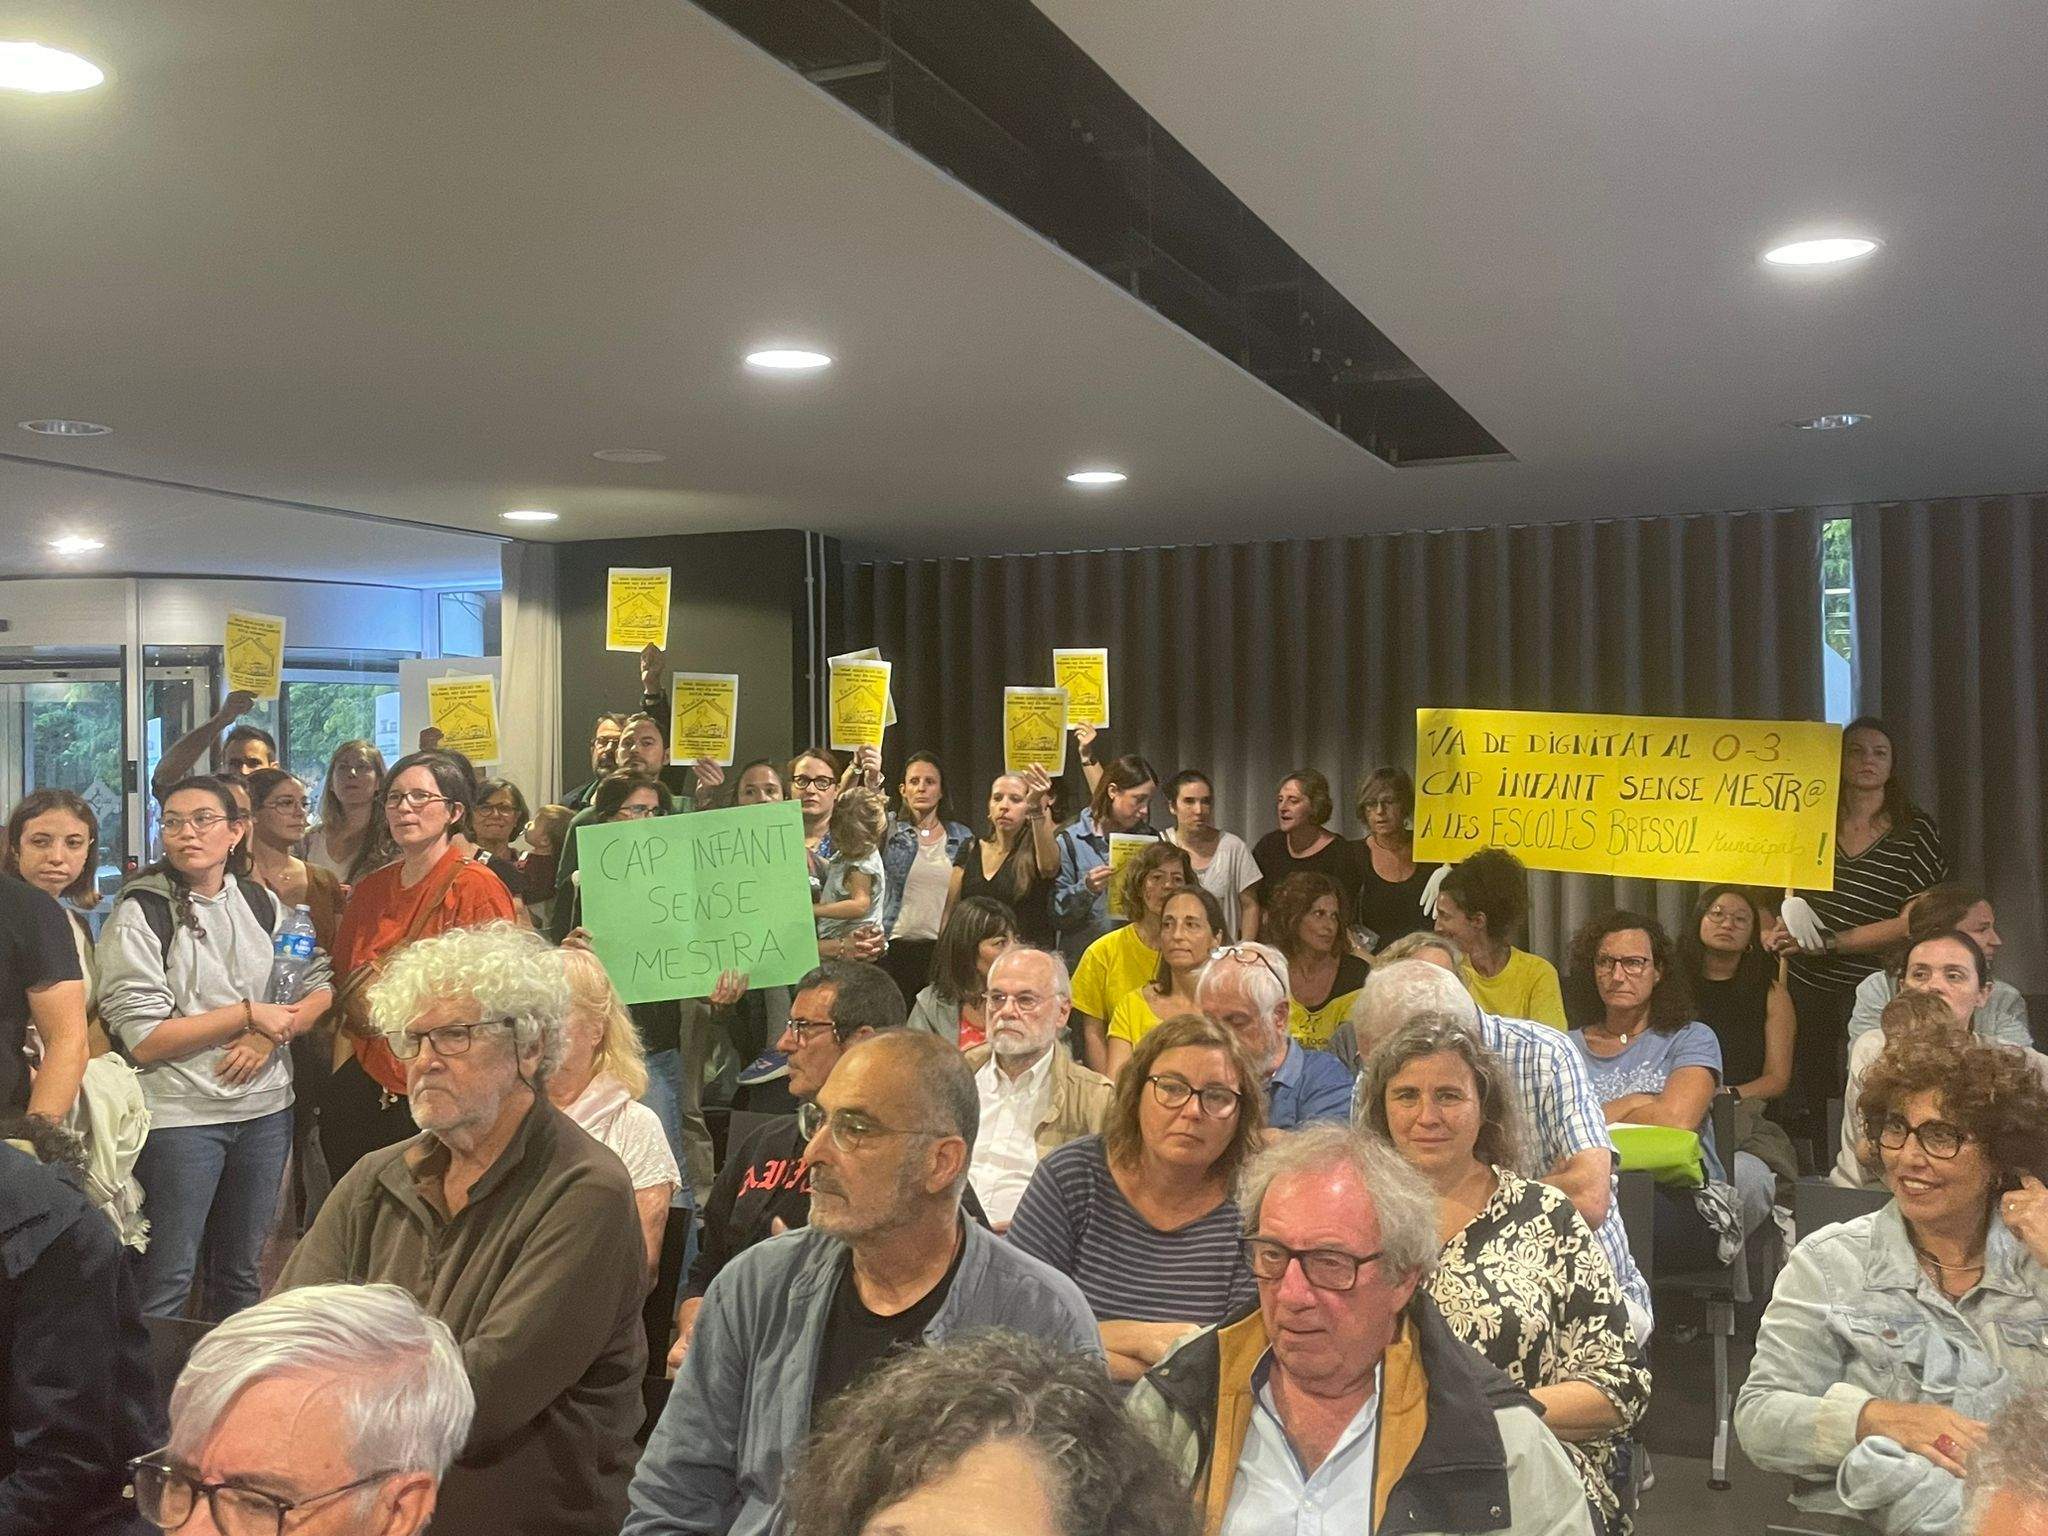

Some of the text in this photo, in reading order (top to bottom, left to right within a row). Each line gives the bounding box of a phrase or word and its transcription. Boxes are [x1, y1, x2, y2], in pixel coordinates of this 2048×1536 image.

[1428, 726, 1467, 757] VA
[1483, 731, 1515, 754] DE
[1661, 733, 1691, 759] AL
[1422, 770, 1483, 796] CAP
[1619, 775, 1705, 801] SENSE
[1714, 772, 1827, 812] MESTR@
[600, 823, 794, 881] CAP INFANT
[1420, 814, 1434, 839] A
[1443, 813, 1480, 840] LES
[1490, 808, 1598, 851] ESCOLES
[1607, 808, 1700, 856] BRESSOL
[648, 880, 760, 924] SENSE
[632, 928, 786, 983] MESTRA
